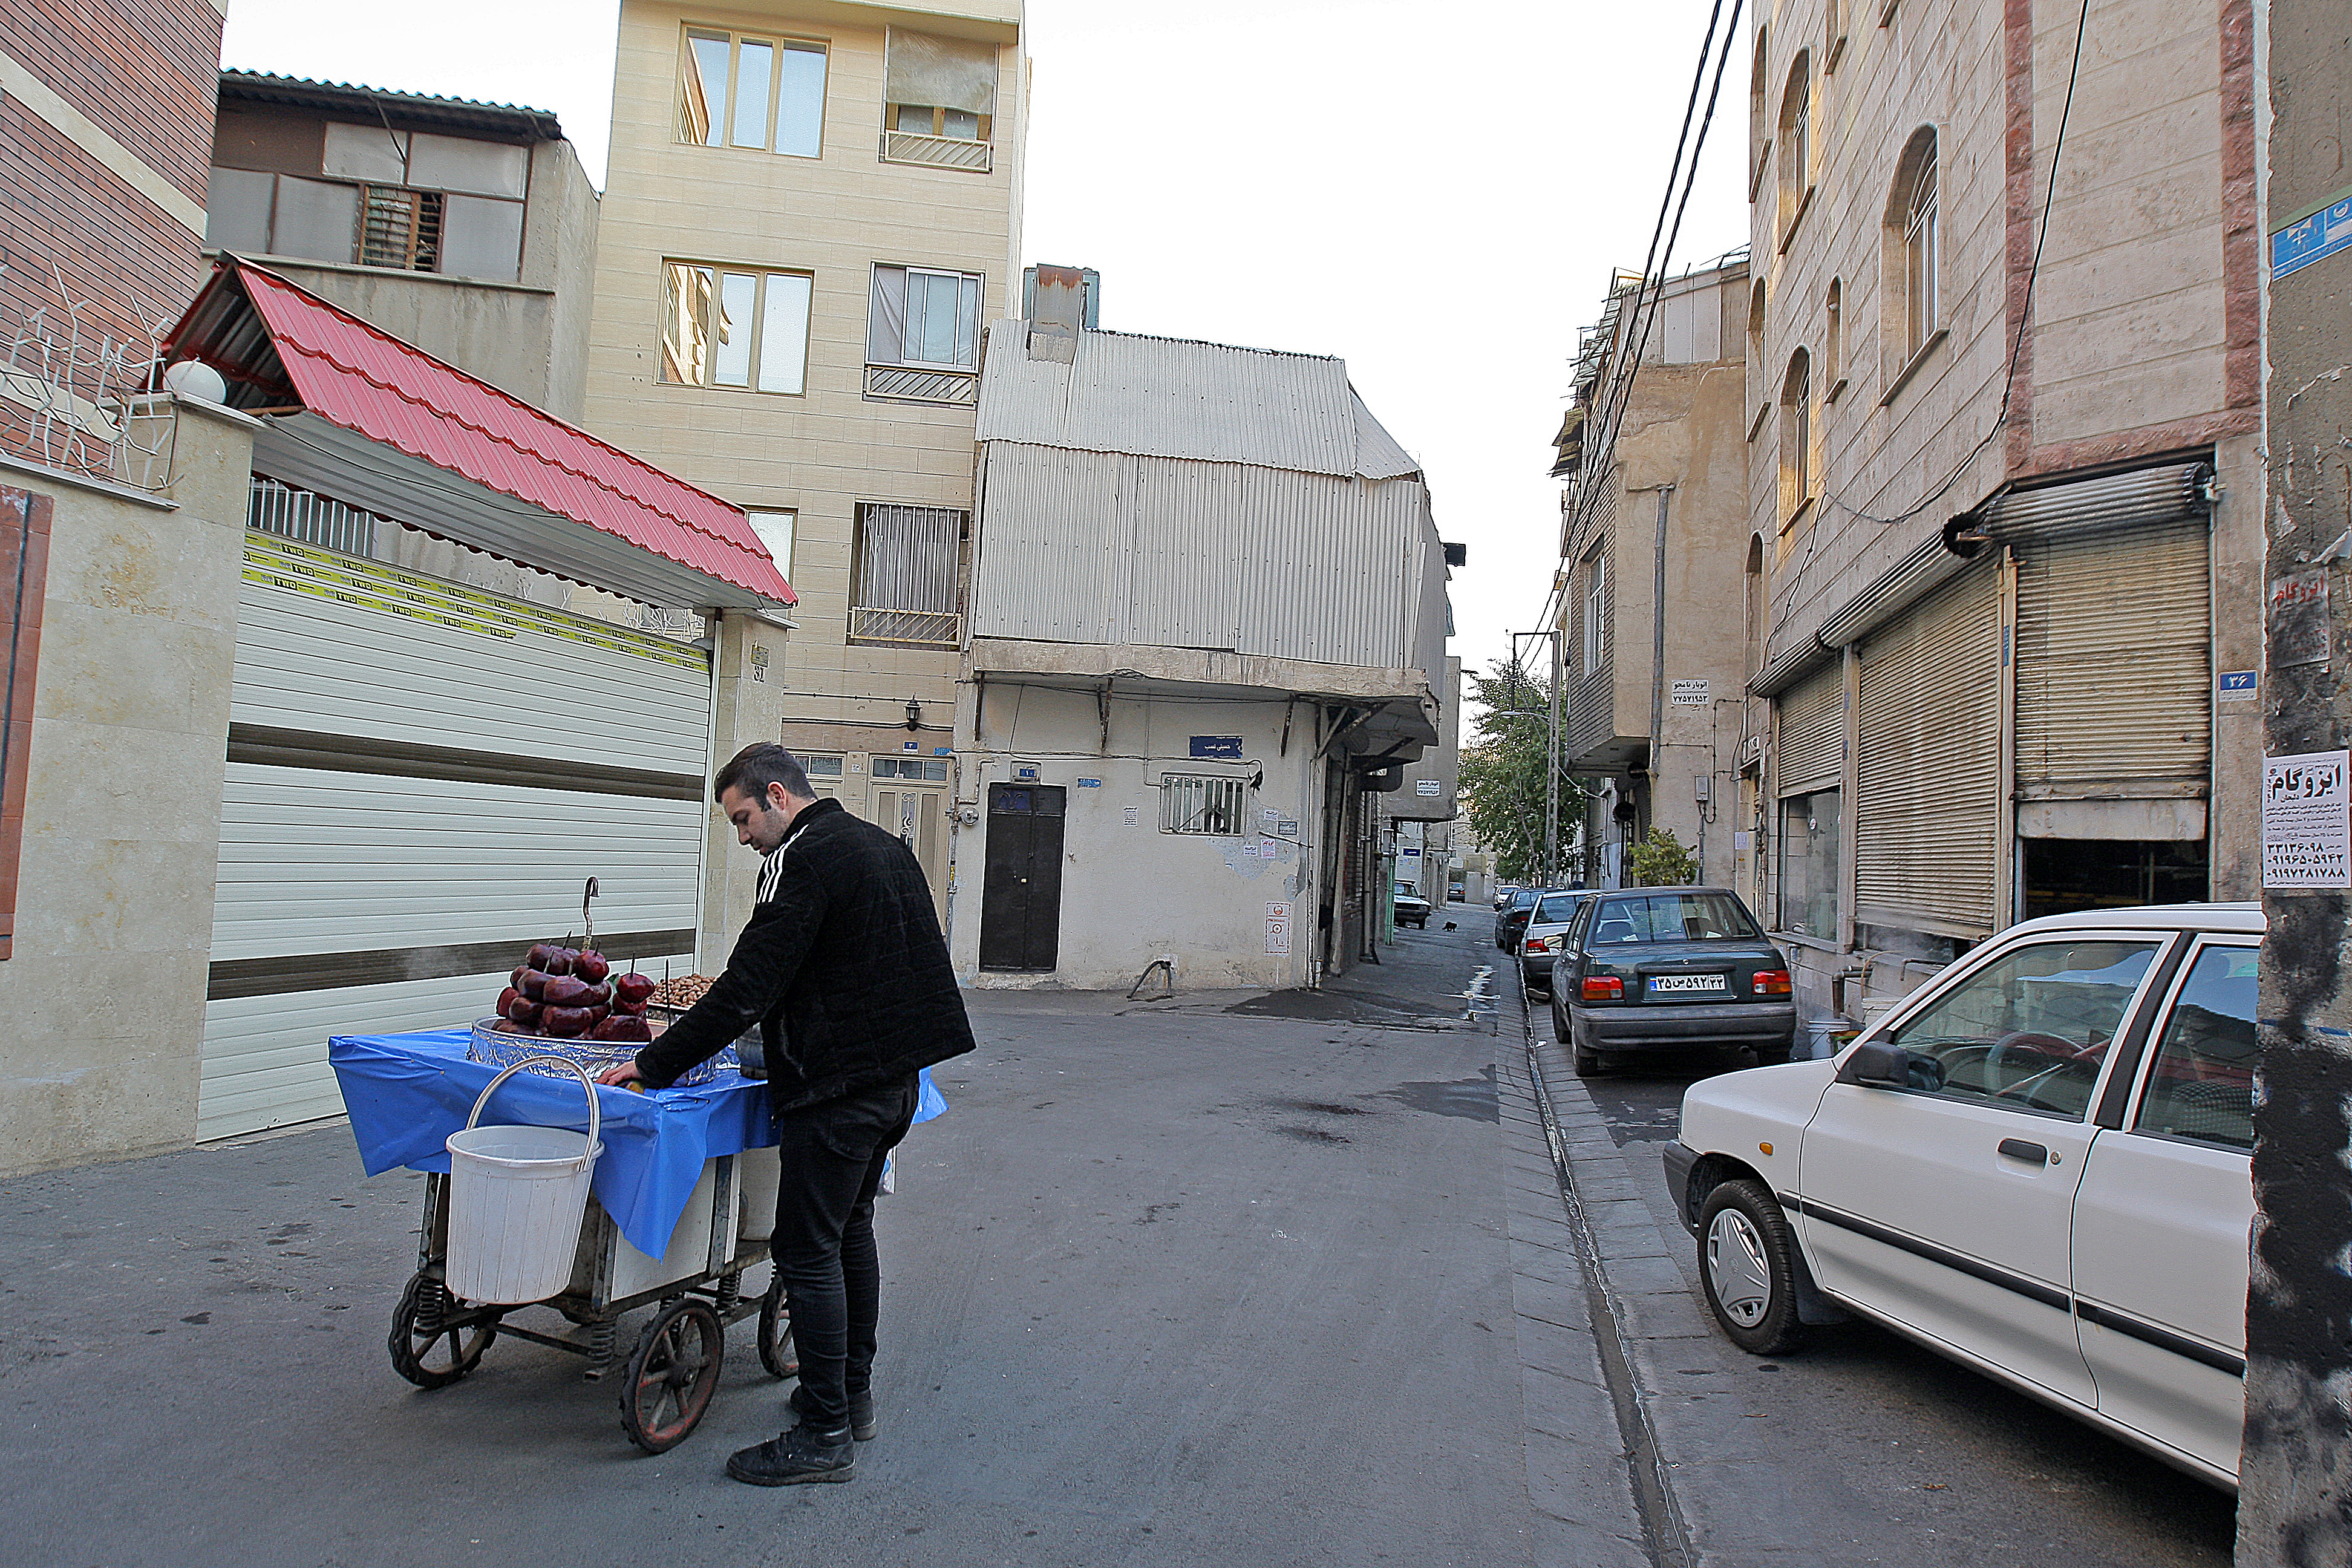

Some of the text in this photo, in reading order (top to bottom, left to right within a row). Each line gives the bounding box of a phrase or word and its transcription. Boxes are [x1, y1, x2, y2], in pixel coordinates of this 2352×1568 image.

[283, 544, 303, 556] TWO
[343, 560, 362, 571] TWO
[399, 575, 416, 585] TWO
[449, 588, 465, 598] TWO
[494, 601, 510, 609] TWO
[275, 578, 296, 589] TWO
[337, 593, 356, 604] TWO
[393, 606, 410, 615] TWO
[444, 618, 460, 627] TWO
[293, 564, 313, 575] TWO
[352, 579, 371, 590] TWO
[408, 593, 425, 603] TWO
[457, 606, 472, 614] TWO
[502, 616, 517, 625] TWO
[1692, 681, 1707, 689] اتوبار
[2229, 675, 2248, 688] ۳۶
[2273, 763, 2341, 800] ایزوگام
[2267, 842, 2324, 854] ۳۳۱۳۶۰۹۸
[2267, 854, 2344, 864] ۰۹۱۹۶۵۰۵۹۴۲
